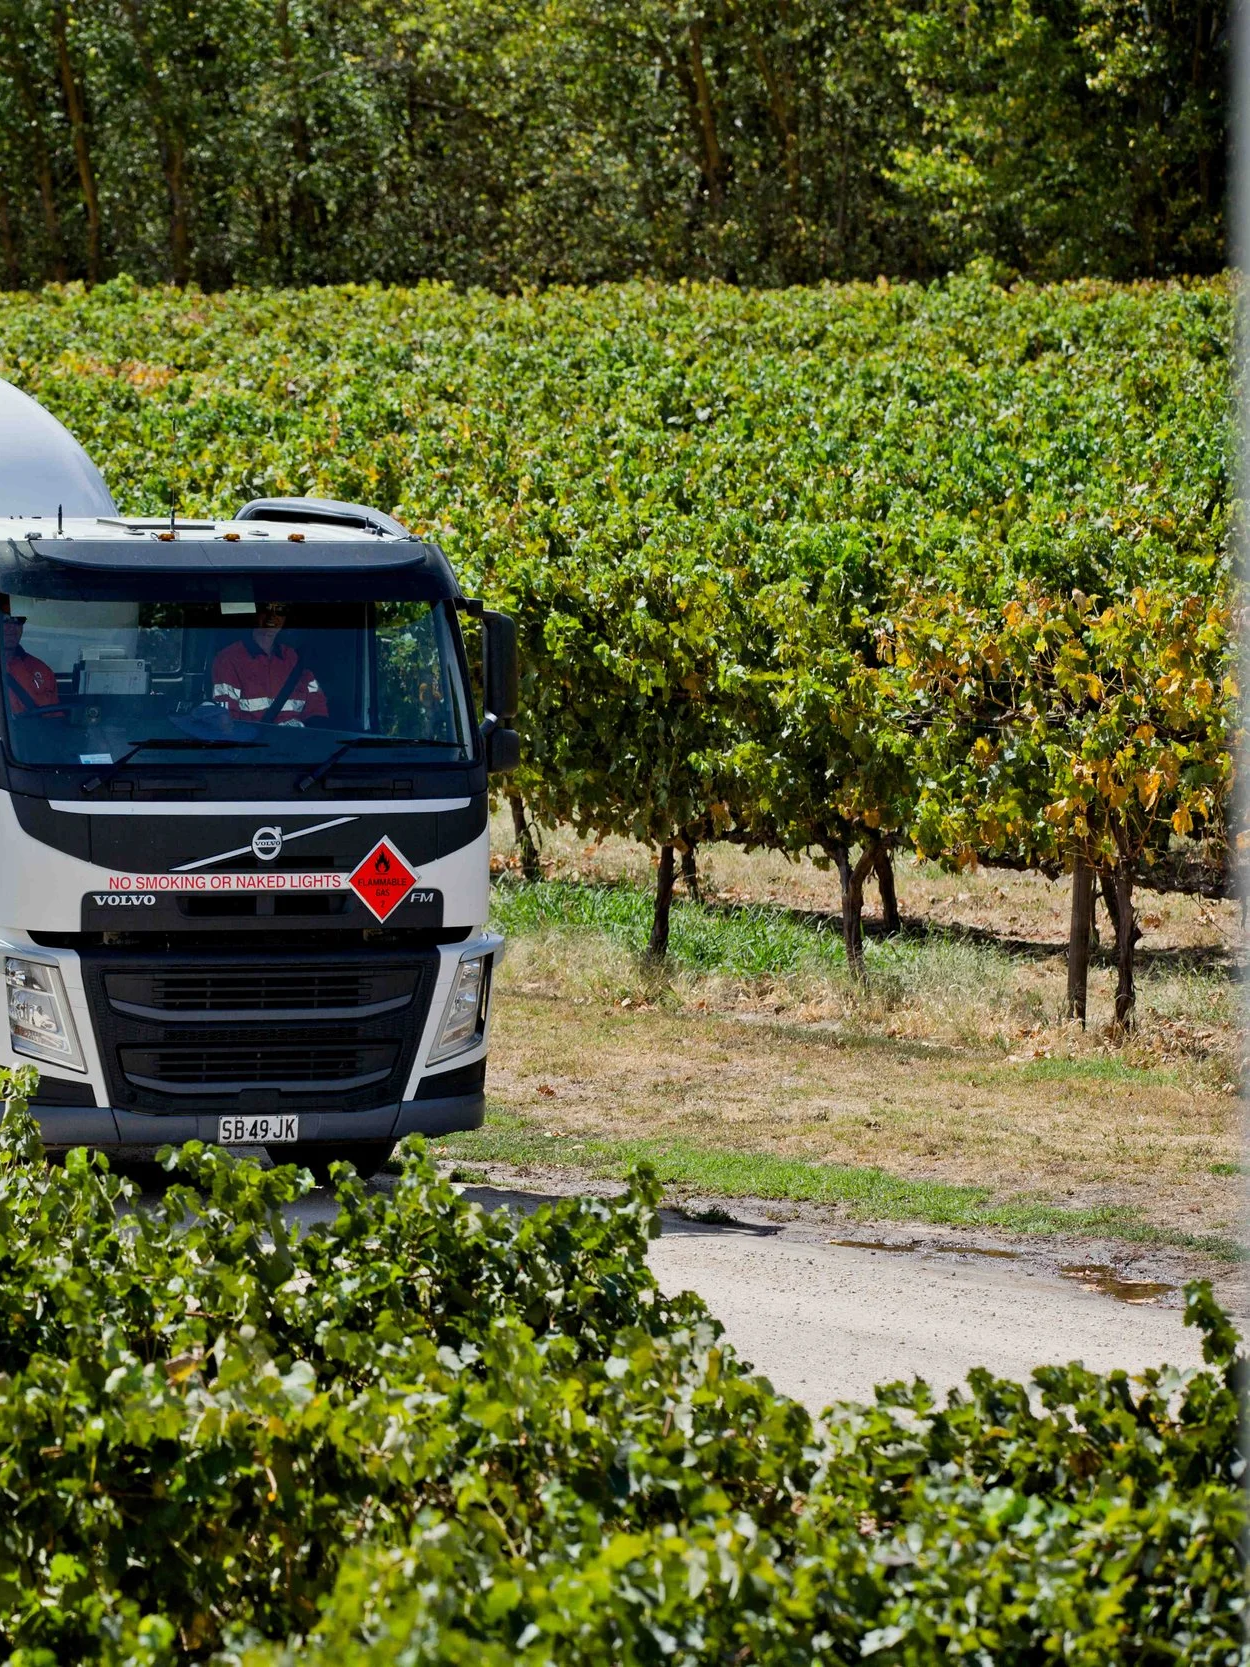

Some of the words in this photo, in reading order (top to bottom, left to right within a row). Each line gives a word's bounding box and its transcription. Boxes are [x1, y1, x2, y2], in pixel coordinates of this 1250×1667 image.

[109, 876, 131, 890] NO
[136, 876, 206, 890] SMOKING
[210, 876, 232, 889] OR
[236, 875, 286, 889] NAKED
[290, 875, 341, 888] LIGHTS
[358, 878, 407, 887] FLAMMABLE
[375, 889, 390, 897] GAS
[410, 892, 434, 903] FM
[92, 895, 156, 906] VOLVO
